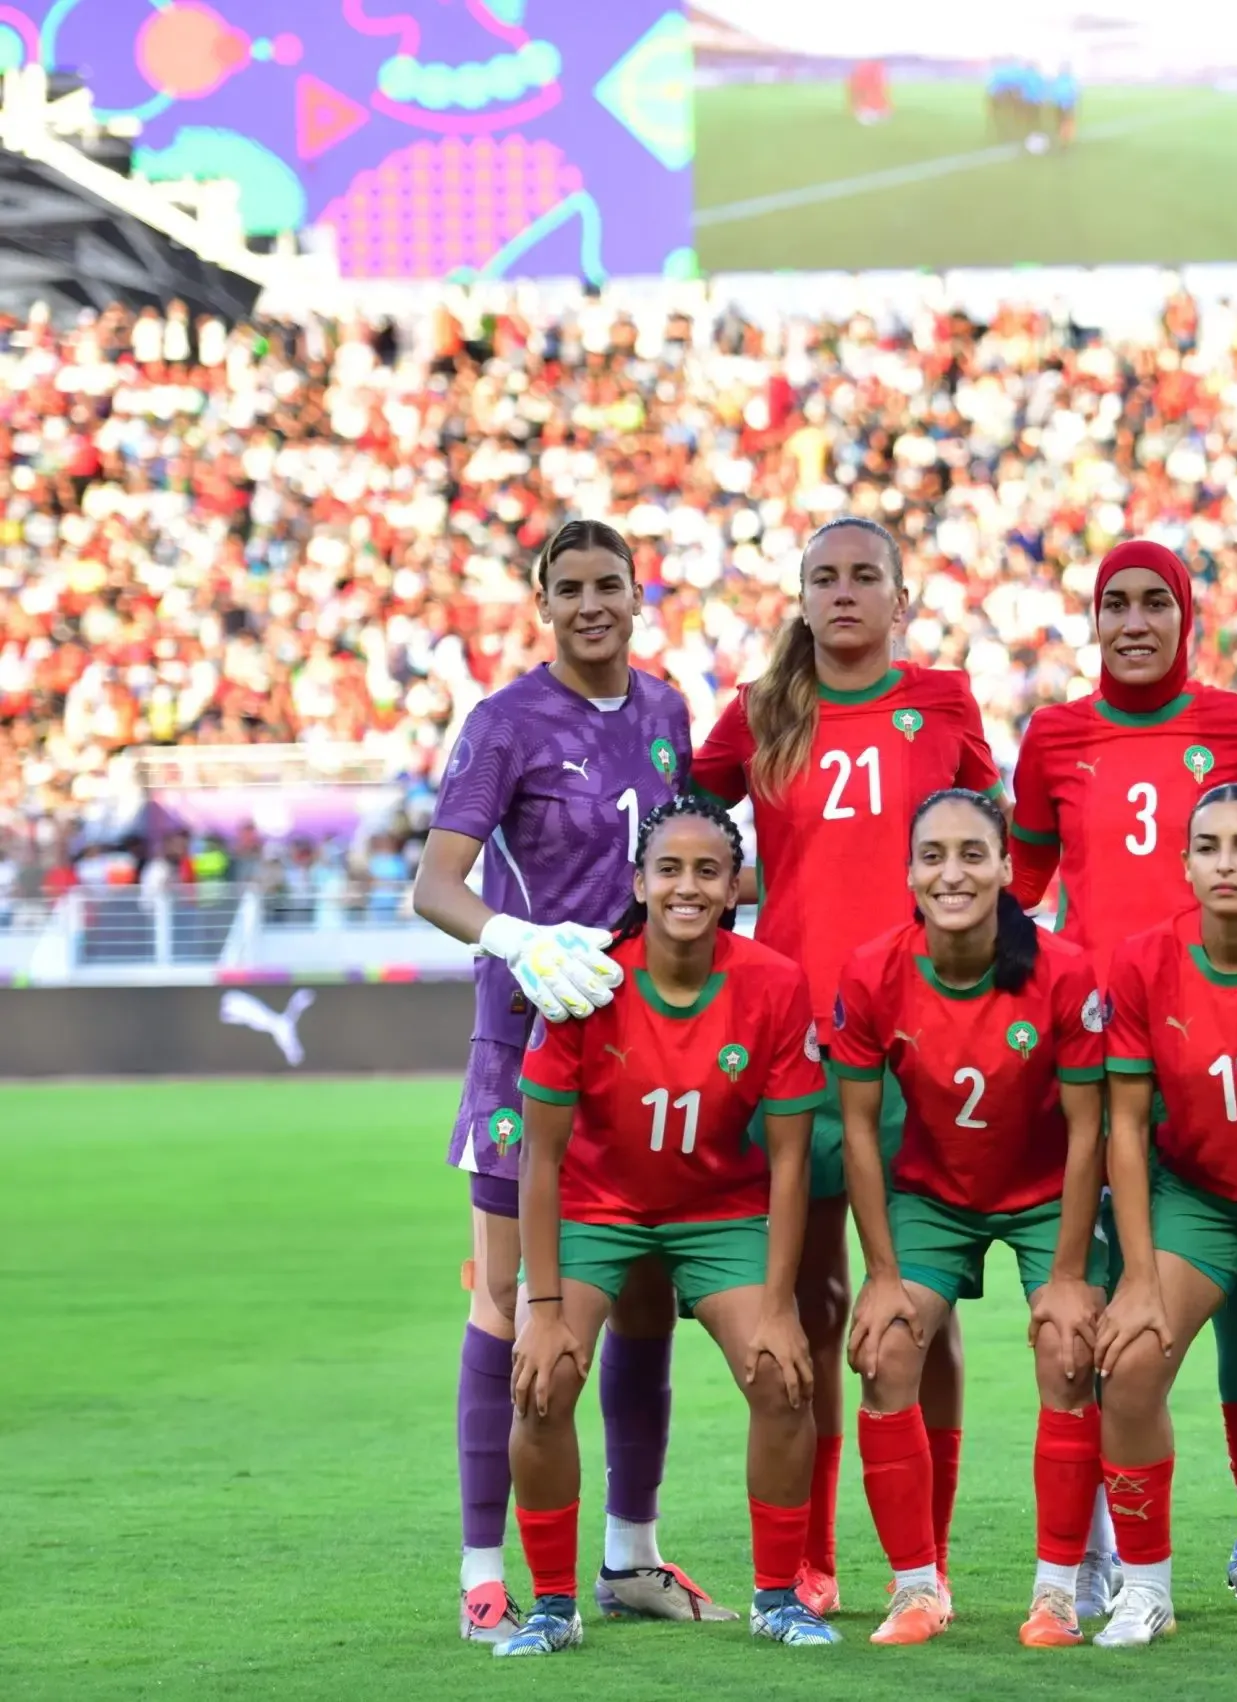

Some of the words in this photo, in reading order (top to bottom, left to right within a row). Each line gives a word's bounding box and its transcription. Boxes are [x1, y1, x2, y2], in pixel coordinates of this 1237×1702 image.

[819, 745, 882, 821] 21
[1125, 781, 1158, 856] 3
[615, 787, 641, 864] 1
[641, 1087, 701, 1154] 11
[953, 1066, 987, 1129] 2
